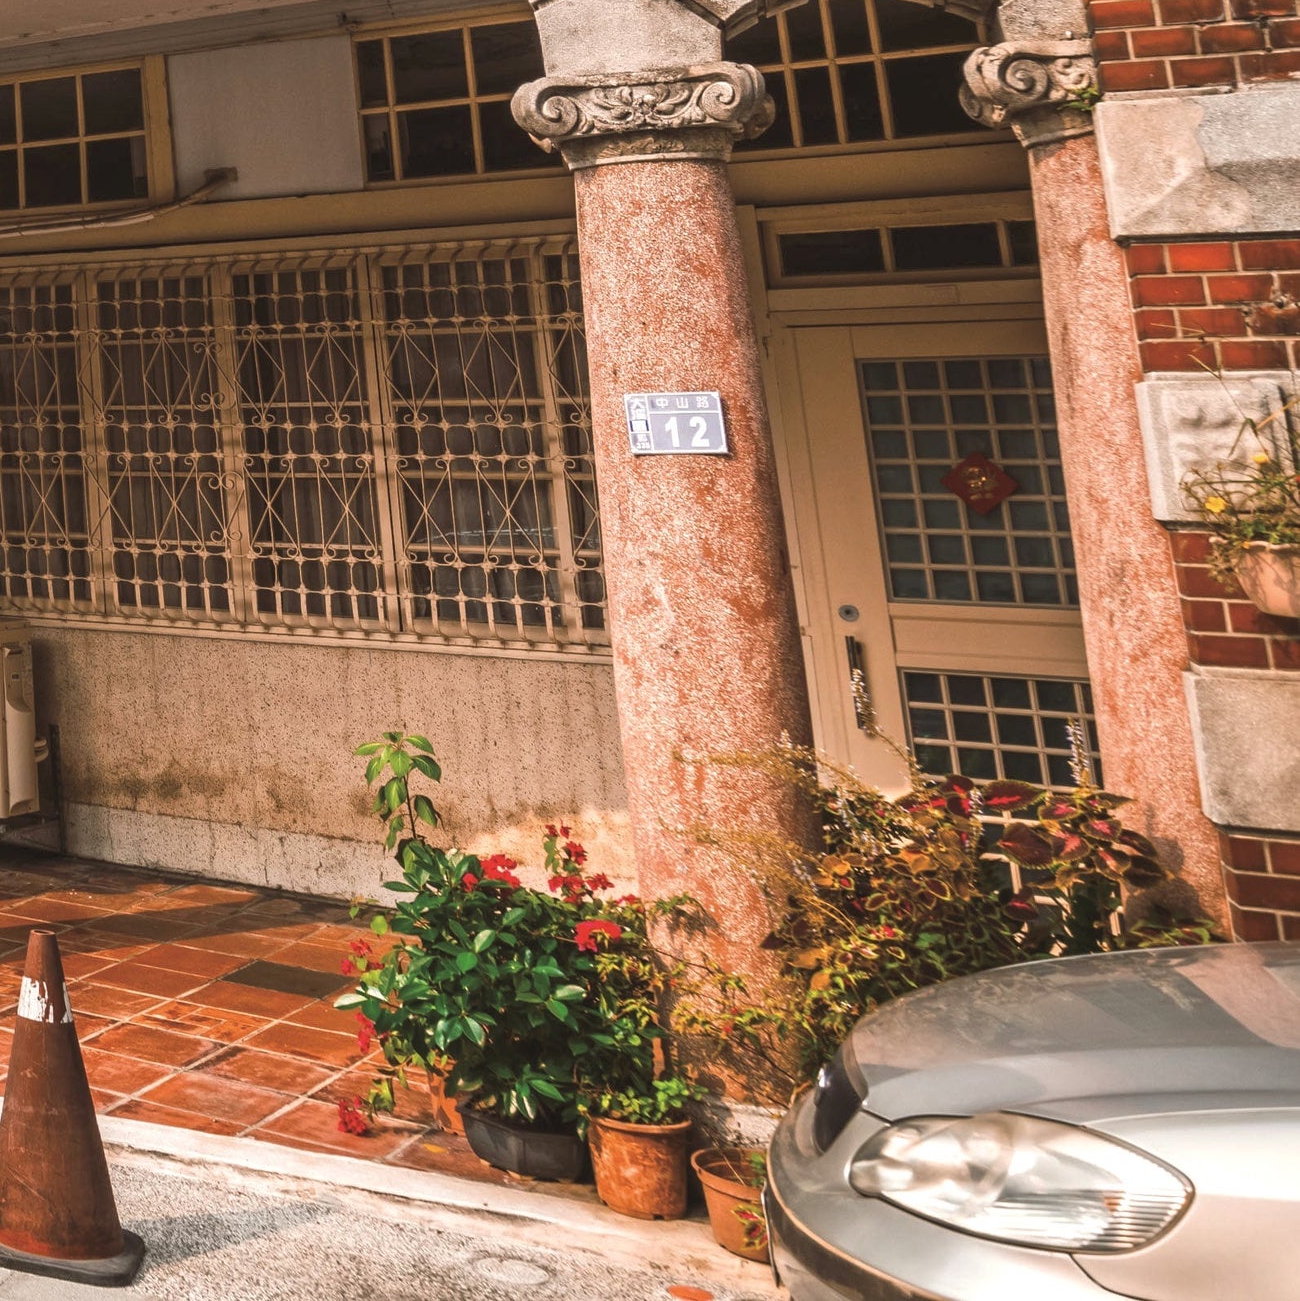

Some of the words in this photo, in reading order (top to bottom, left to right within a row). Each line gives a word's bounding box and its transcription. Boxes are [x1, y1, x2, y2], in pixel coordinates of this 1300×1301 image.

[655, 396, 710, 409] 中山路
[664, 416, 710, 448] 12
